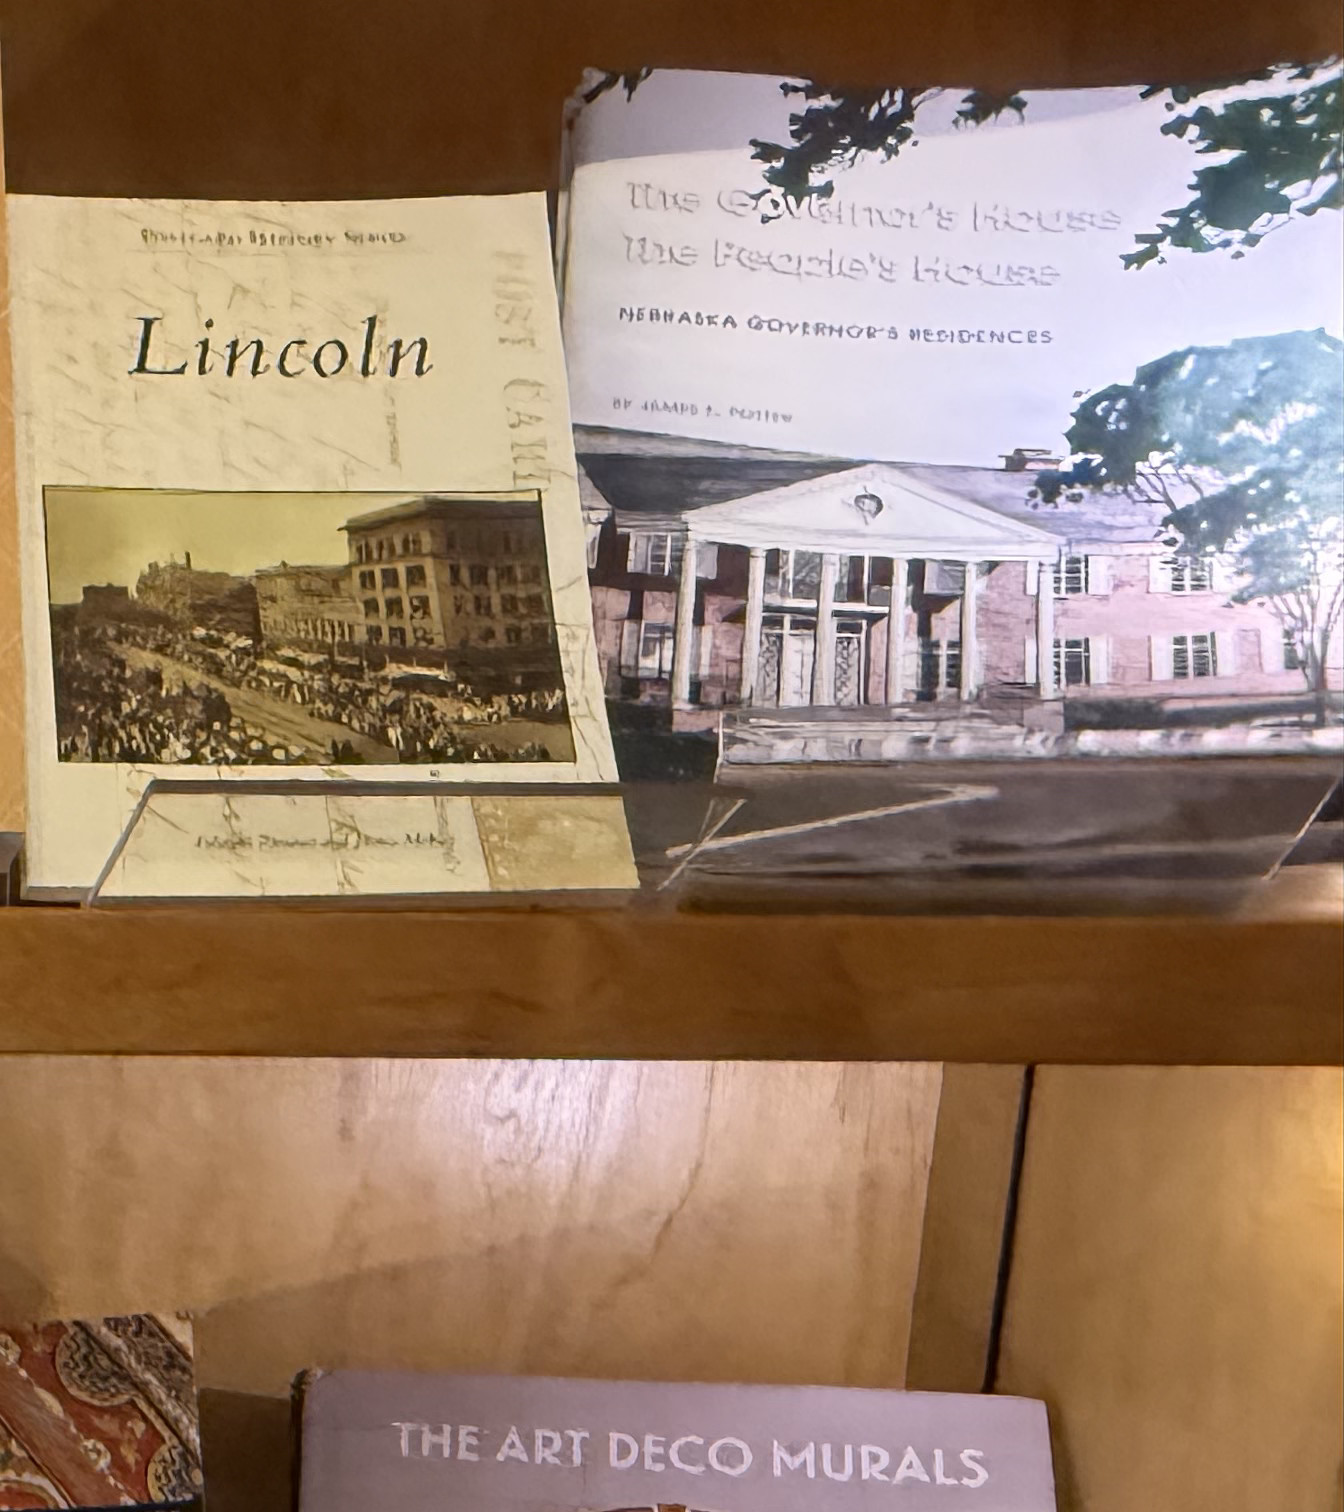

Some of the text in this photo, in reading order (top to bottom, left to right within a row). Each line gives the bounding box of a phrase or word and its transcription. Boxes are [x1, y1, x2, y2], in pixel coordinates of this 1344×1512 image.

[127, 314, 434, 378] Lincoln
[391, 1421, 990, 1488] THE ART DECO MURALS
